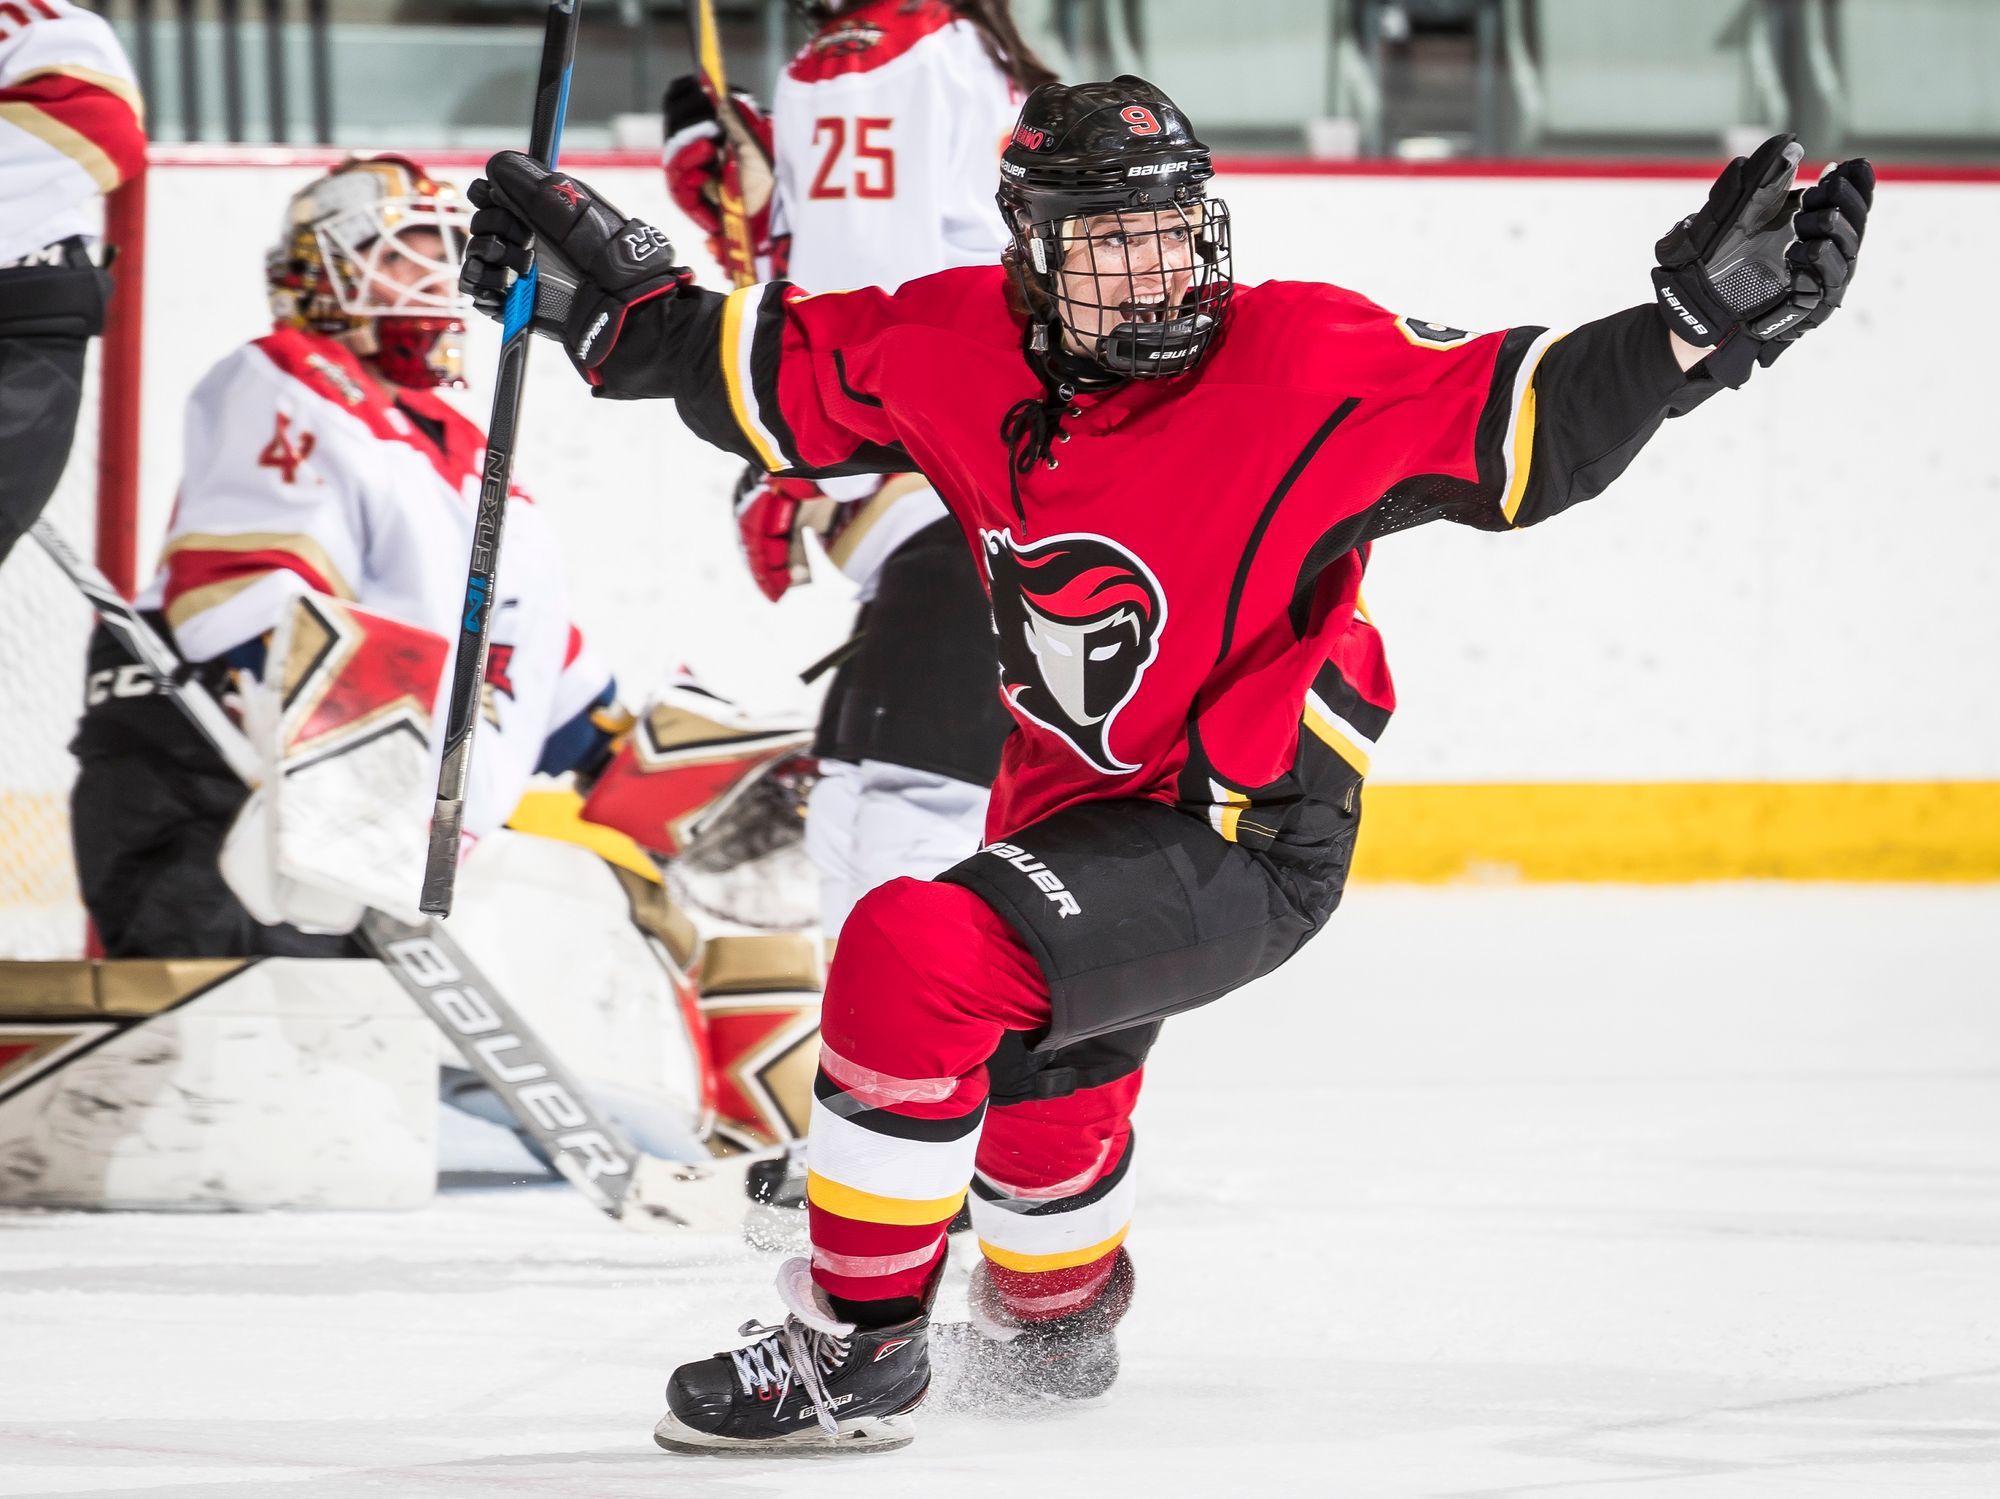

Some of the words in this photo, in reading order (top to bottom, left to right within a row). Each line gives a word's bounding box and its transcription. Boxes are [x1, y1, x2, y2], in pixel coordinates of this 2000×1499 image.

[1120, 106, 1161, 136] 9
[808, 117, 896, 200] 25
[1127, 161, 1189, 178] BAUER
[1660, 286, 1709, 336] BAUER
[575, 312, 609, 360] BAUER
[472, 450, 505, 574] NEXUS
[88, 663, 160, 706] CC
[387, 936, 629, 1181] BAUER
